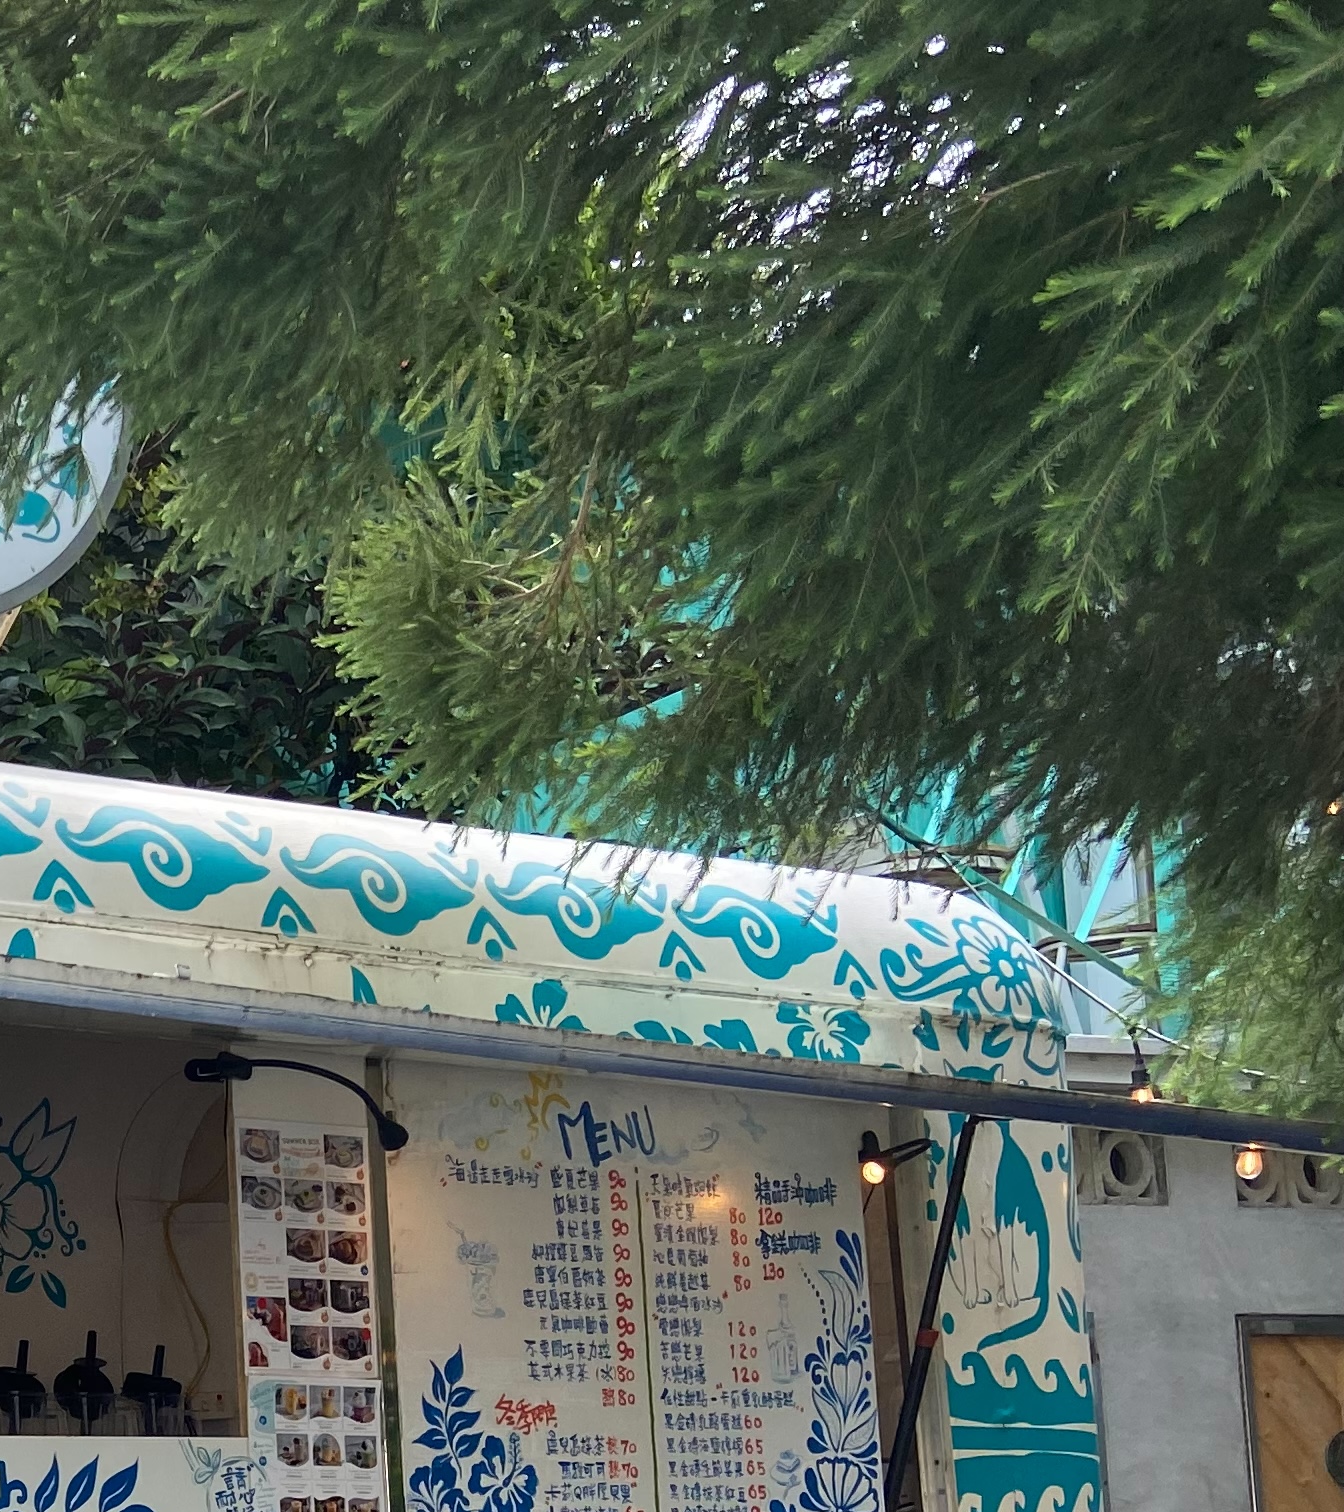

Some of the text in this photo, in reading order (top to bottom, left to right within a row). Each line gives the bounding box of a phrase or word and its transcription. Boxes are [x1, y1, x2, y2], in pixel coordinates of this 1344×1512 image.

[558, 1101, 656, 1168] MENU
[608, 1169, 627, 1189] 90
[610, 1192, 628, 1212] 90
[728, 1207, 747, 1225] 80
[757, 1208, 783, 1226] 120
[611, 1218, 629, 1237] 90
[730, 1229, 748, 1246] 80
[613, 1243, 631, 1263] 90
[732, 1251, 751, 1267] 80
[614, 1267, 633, 1288] 90
[762, 1262, 785, 1281] 130
[734, 1274, 752, 1292] 80
[615, 1292, 634, 1313] 90
[616, 1316, 636, 1338] 90
[728, 1321, 757, 1337] 120
[617, 1341, 635, 1362] 90
[730, 1343, 758, 1360] 120
[617, 1365, 635, 1383] 80
[732, 1367, 760, 1384] 120
[618, 1389, 635, 1406] 80
[744, 1414, 762, 1430] 60
[621, 1439, 637, 1455] 70
[745, 1438, 763, 1455] 65
[621, 1462, 638, 1479] 70
[746, 1460, 766, 1476] 65
[748, 1484, 767, 1500] 65
